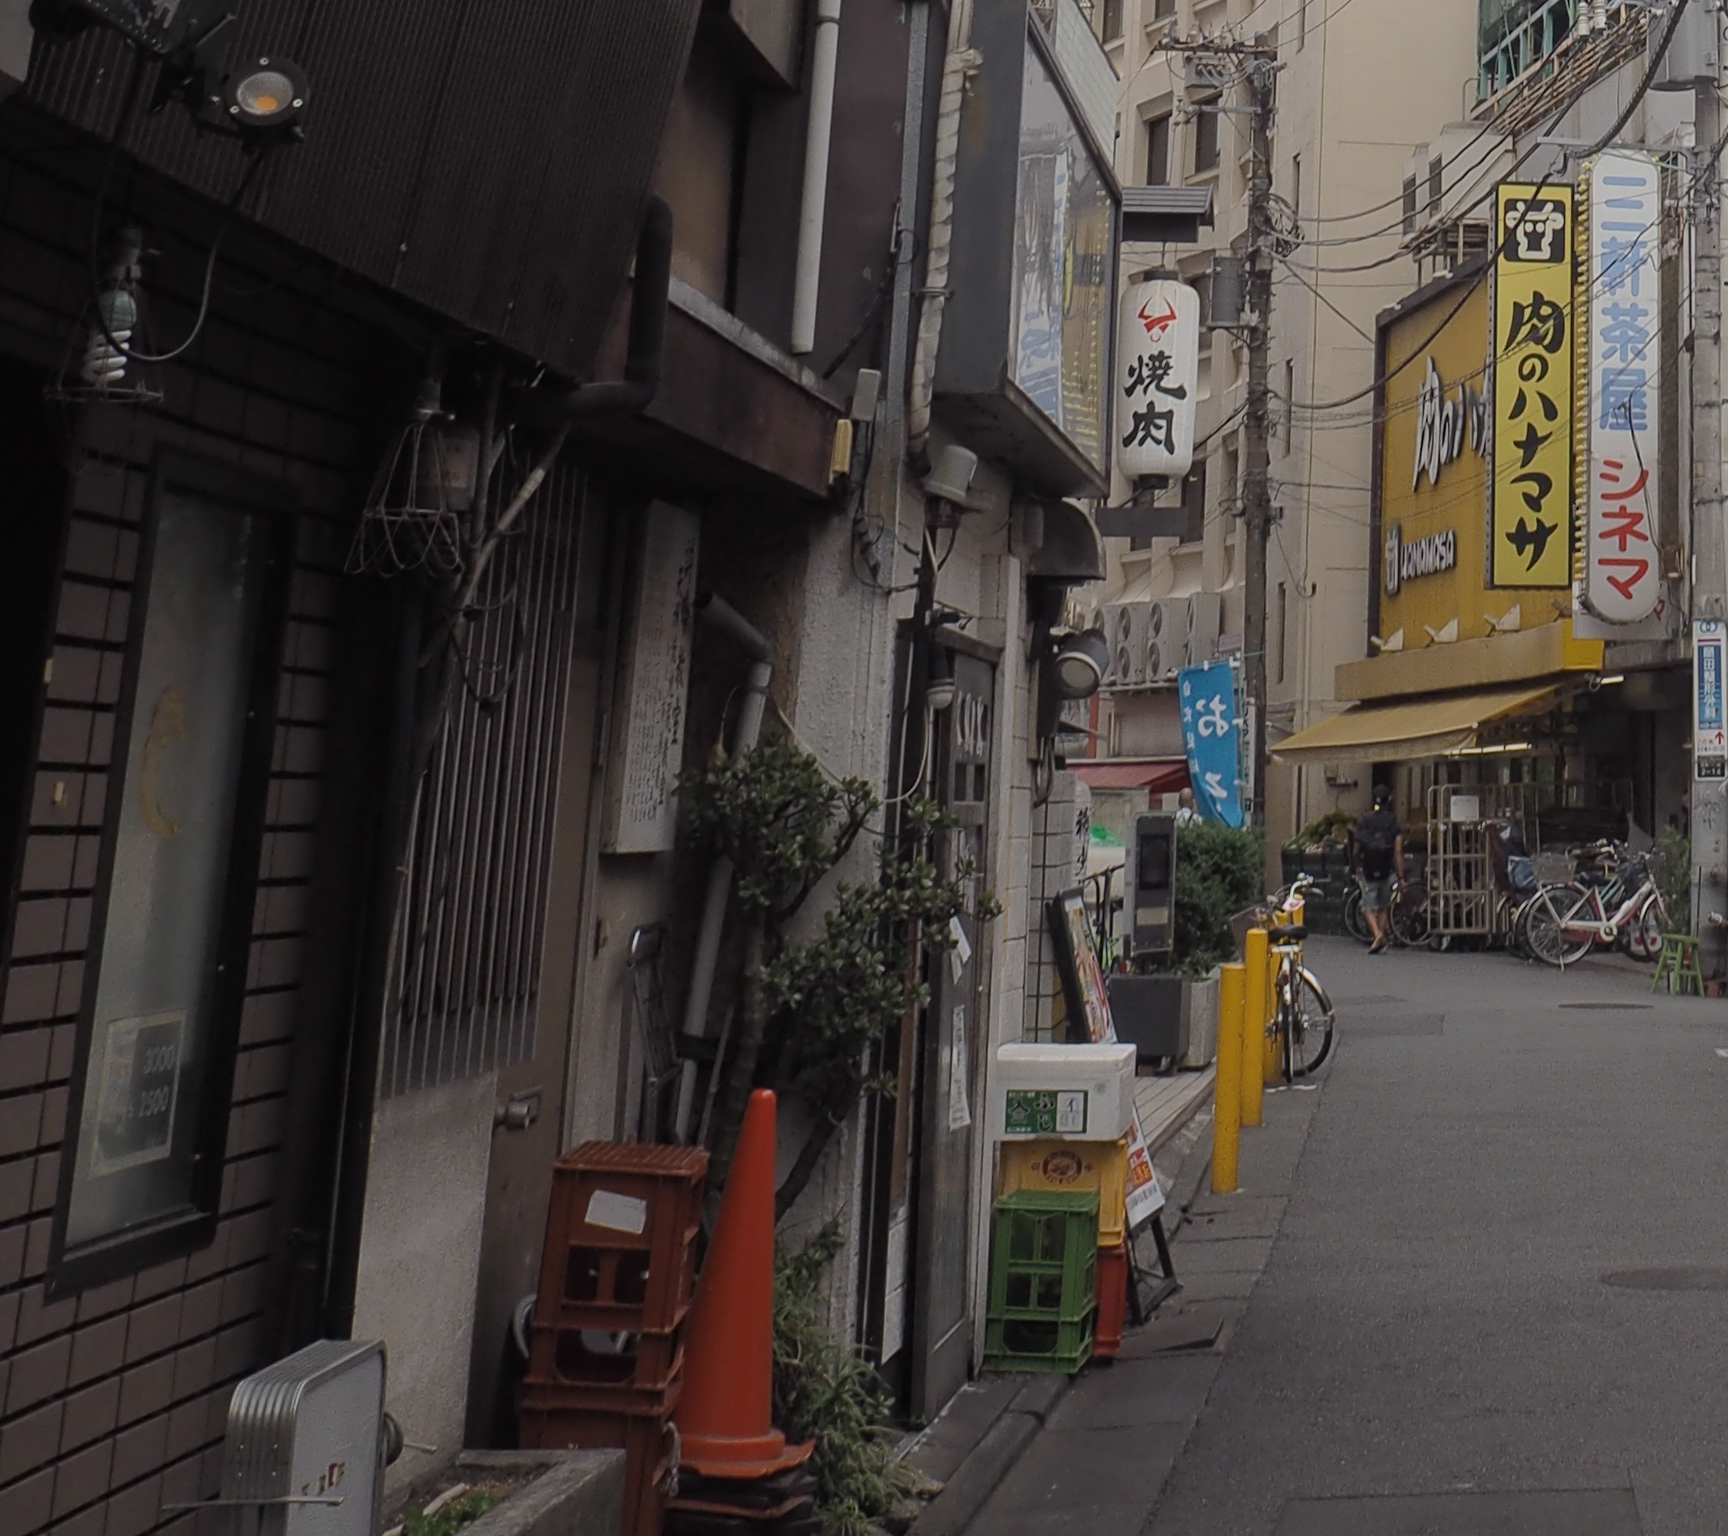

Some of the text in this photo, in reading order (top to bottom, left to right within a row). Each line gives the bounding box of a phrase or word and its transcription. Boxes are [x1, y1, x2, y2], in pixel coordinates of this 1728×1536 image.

[1121, 349, 1187, 456] 焼肉
[1503, 290, 1566, 573] 肉のハナマサ
[1597, 458, 1649, 601] シネマ
